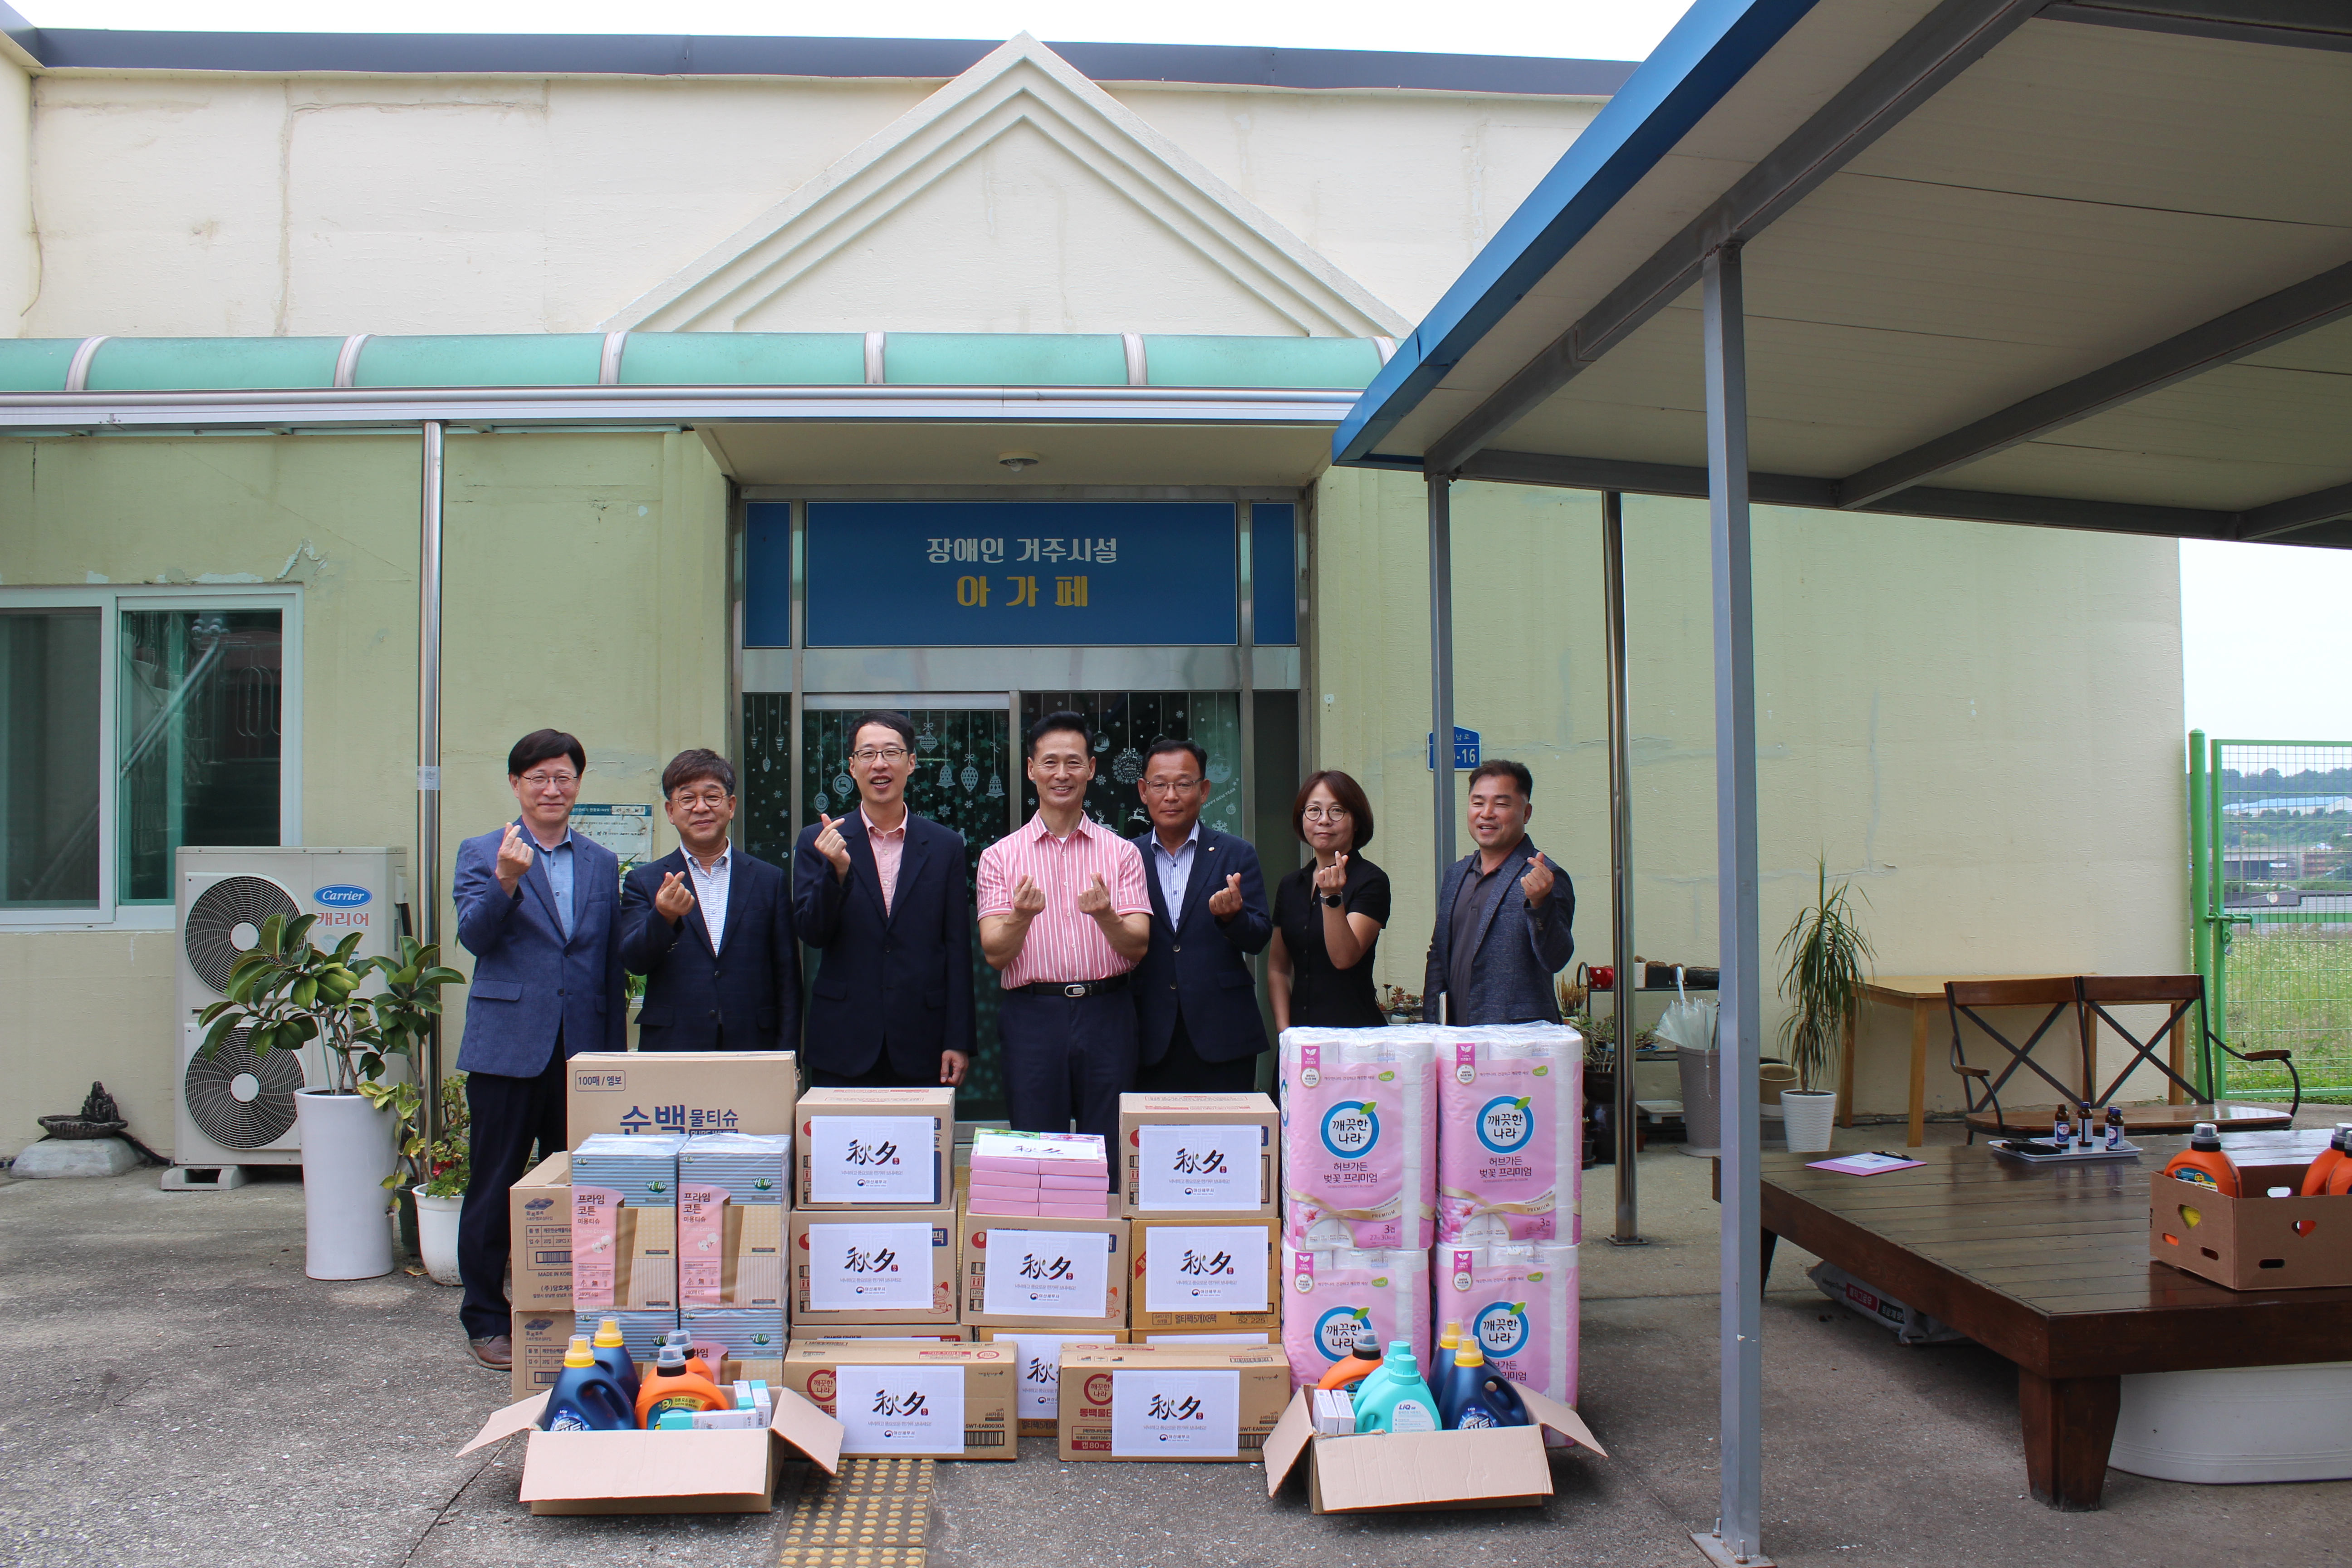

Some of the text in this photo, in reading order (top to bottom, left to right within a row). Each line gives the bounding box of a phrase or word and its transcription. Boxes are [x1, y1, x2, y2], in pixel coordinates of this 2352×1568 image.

[926, 538, 1117, 564] 장애인 거주시설
[1202, 799, 1215, 809] HAPPY
[322, 889, 364, 902] Carrier
[316, 912, 369, 926] 캐리어
[578, 1076, 600, 1086] 100매
[607, 1076, 622, 1086] 엠보
[689, 1109, 739, 1127] 물티슈
[1487, 1115, 1523, 1127] 깨끗한
[1332, 1119, 1368, 1131] 깨끗한
[1338, 1133, 1362, 1144] 나라
[1494, 1128, 1517, 1140] 나라
[846, 1139, 897, 1165] 秋夕
[1173, 1148, 1224, 1174] 秋夕
[1333, 1162, 1368, 1171] 허브가든
[1489, 1156, 1522, 1166] 허브가든
[1324, 1173, 1377, 1183] 벚꽃 프리미엄
[1480, 1167, 1532, 1178] 벚꽃 프리미엄
[646, 1181, 666, 1191] Hello
[752, 1177, 773, 1187] Hello
[578, 1195, 604, 1205] 프라임
[683, 1192, 710, 1202] 프라임
[577, 1206, 596, 1216] 코튼
[683, 1204, 702, 1214] 코튼
[1527, 1203, 1550, 1212] PREMIUM
[1372, 1210, 1396, 1218] PREMIUM
[1540, 1218, 1550, 1227] 3겹
[1384, 1225, 1395, 1234] 3겹
[844, 1246, 895, 1273] 秋夕
[1180, 1250, 1231, 1275] 秋夕
[1019, 1253, 1071, 1280] 秋夕
[1326, 1323, 1361, 1336] 깨끗한
[1483, 1318, 1518, 1332] 깨끗한
[652, 1335, 667, 1345] Hell
[750, 1333, 770, 1344] Hello
[1332, 1338, 1354, 1349] 나라
[1489, 1332, 1512, 1344] 나라
[693, 1348, 709, 1357] 라임
[1027, 1357, 1058, 1383] 秋
[1502, 1372, 1526, 1381] 리미엄
[813, 1379, 833, 1387] 깨끗한
[872, 1389, 926, 1416] 秋夕
[1148, 1394, 1200, 1420] 秋夕
